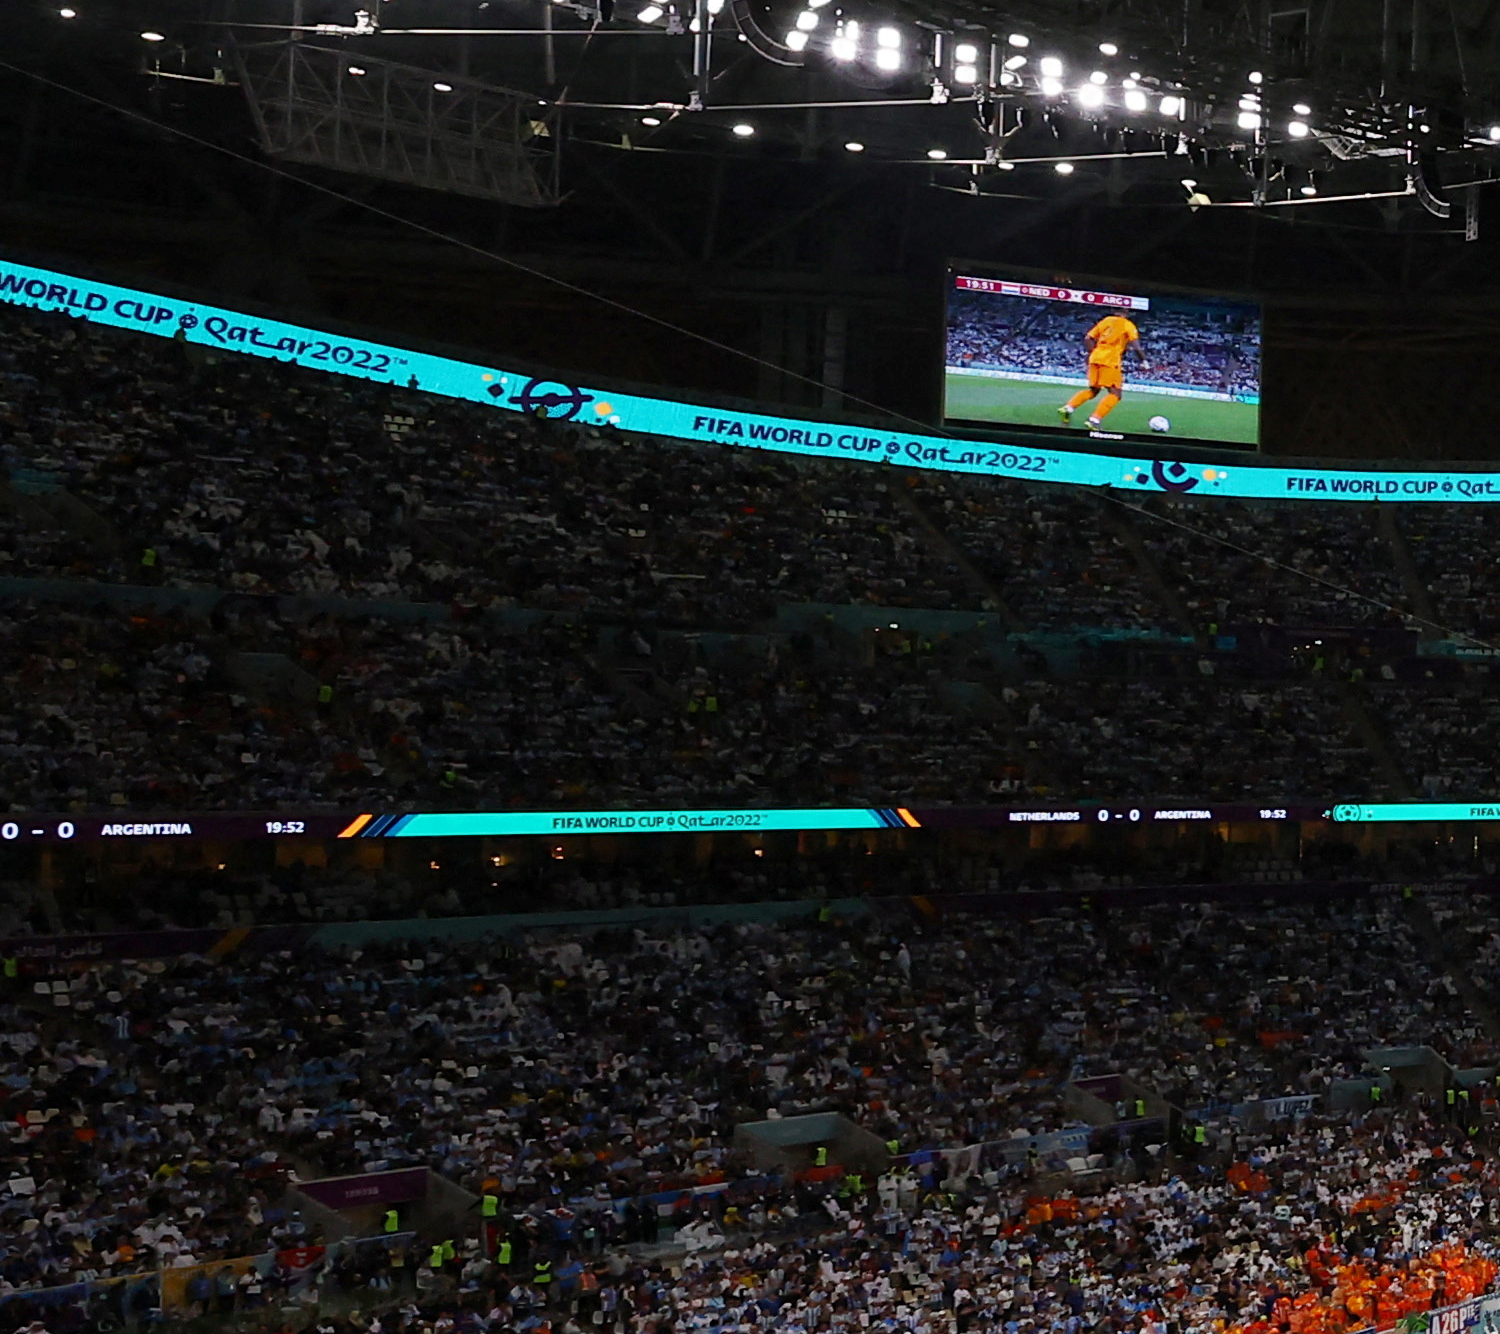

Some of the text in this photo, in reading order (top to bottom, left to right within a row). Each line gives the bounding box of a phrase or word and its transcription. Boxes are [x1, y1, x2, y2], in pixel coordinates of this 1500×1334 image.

[1102, 295, 1122, 307] ARG
[114, 300, 173, 324] CUP
[693, 416, 744, 437] FIFA
[750, 424, 832, 447] WORLD
[838, 435, 881, 452] CUP
[1287, 478, 1327, 491] FIFA
[1331, 479, 1398, 493] WORLD
[1403, 481, 1438, 493] CUP
[552, 817, 583, 830] FIFA
[584, 816, 635, 829] WORLD
[637, 816, 664, 828] CUP
[1009, 811, 1080, 822] NETHERLANDS
[1097, 809, 1109, 822] 0
[1129, 809, 1140, 822] 0
[1153, 810, 1212, 820] ARGENTINA
[1259, 809, 1287, 819] 19:52
[1, 822, 19, 840] 0
[57, 821, 74, 839] 0
[101, 823, 192, 836] ARGENTINA
[265, 821, 305, 834] 19:52
